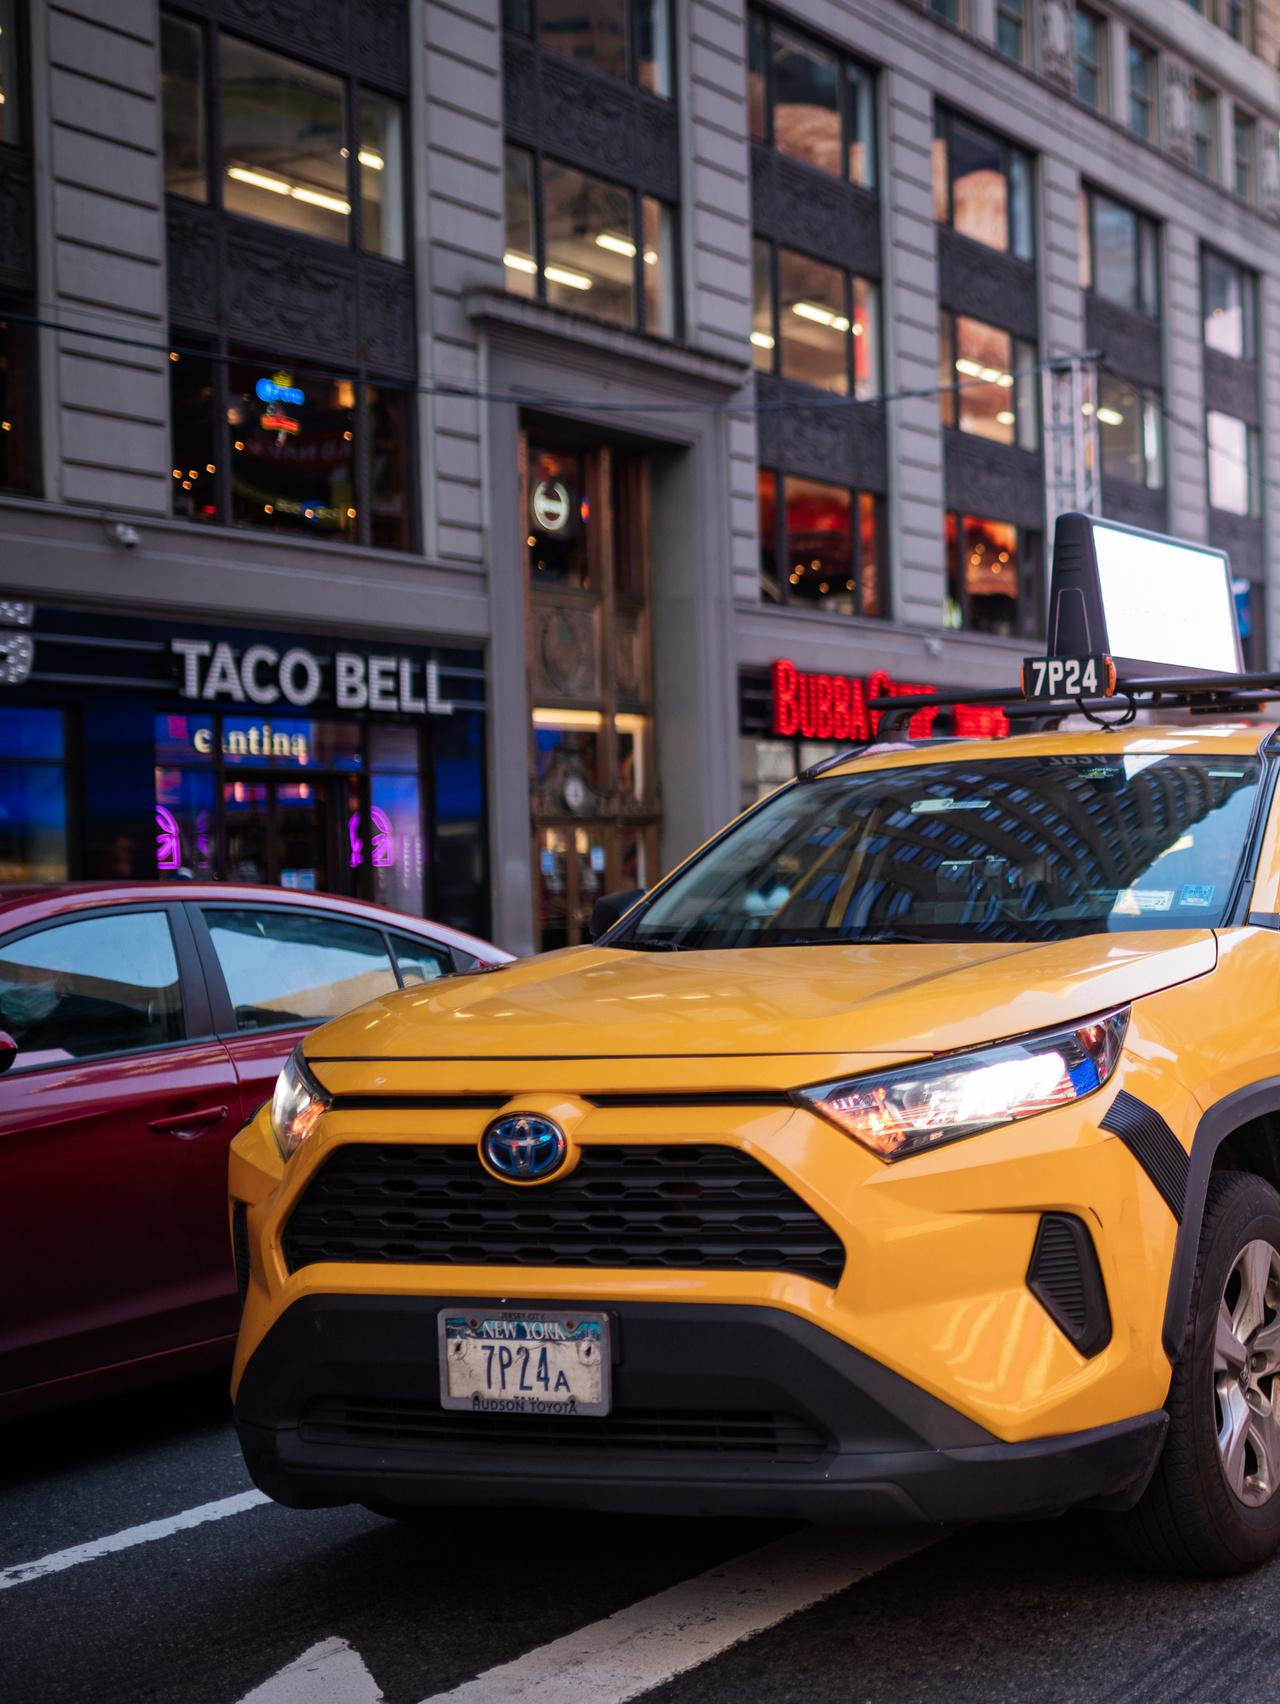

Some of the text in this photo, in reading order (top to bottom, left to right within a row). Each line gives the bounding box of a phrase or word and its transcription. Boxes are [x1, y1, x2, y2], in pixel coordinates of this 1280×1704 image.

[171, 638, 454, 716] TACO BELL
[1032, 658, 1098, 697] 7P24
[194, 725, 307, 756] cntina
[501, 1311, 545, 1320] JERSEY CITY
[482, 1320, 566, 1340] NEW YORK
[472, 1400, 578, 1414] HUDSON TOYOTA
